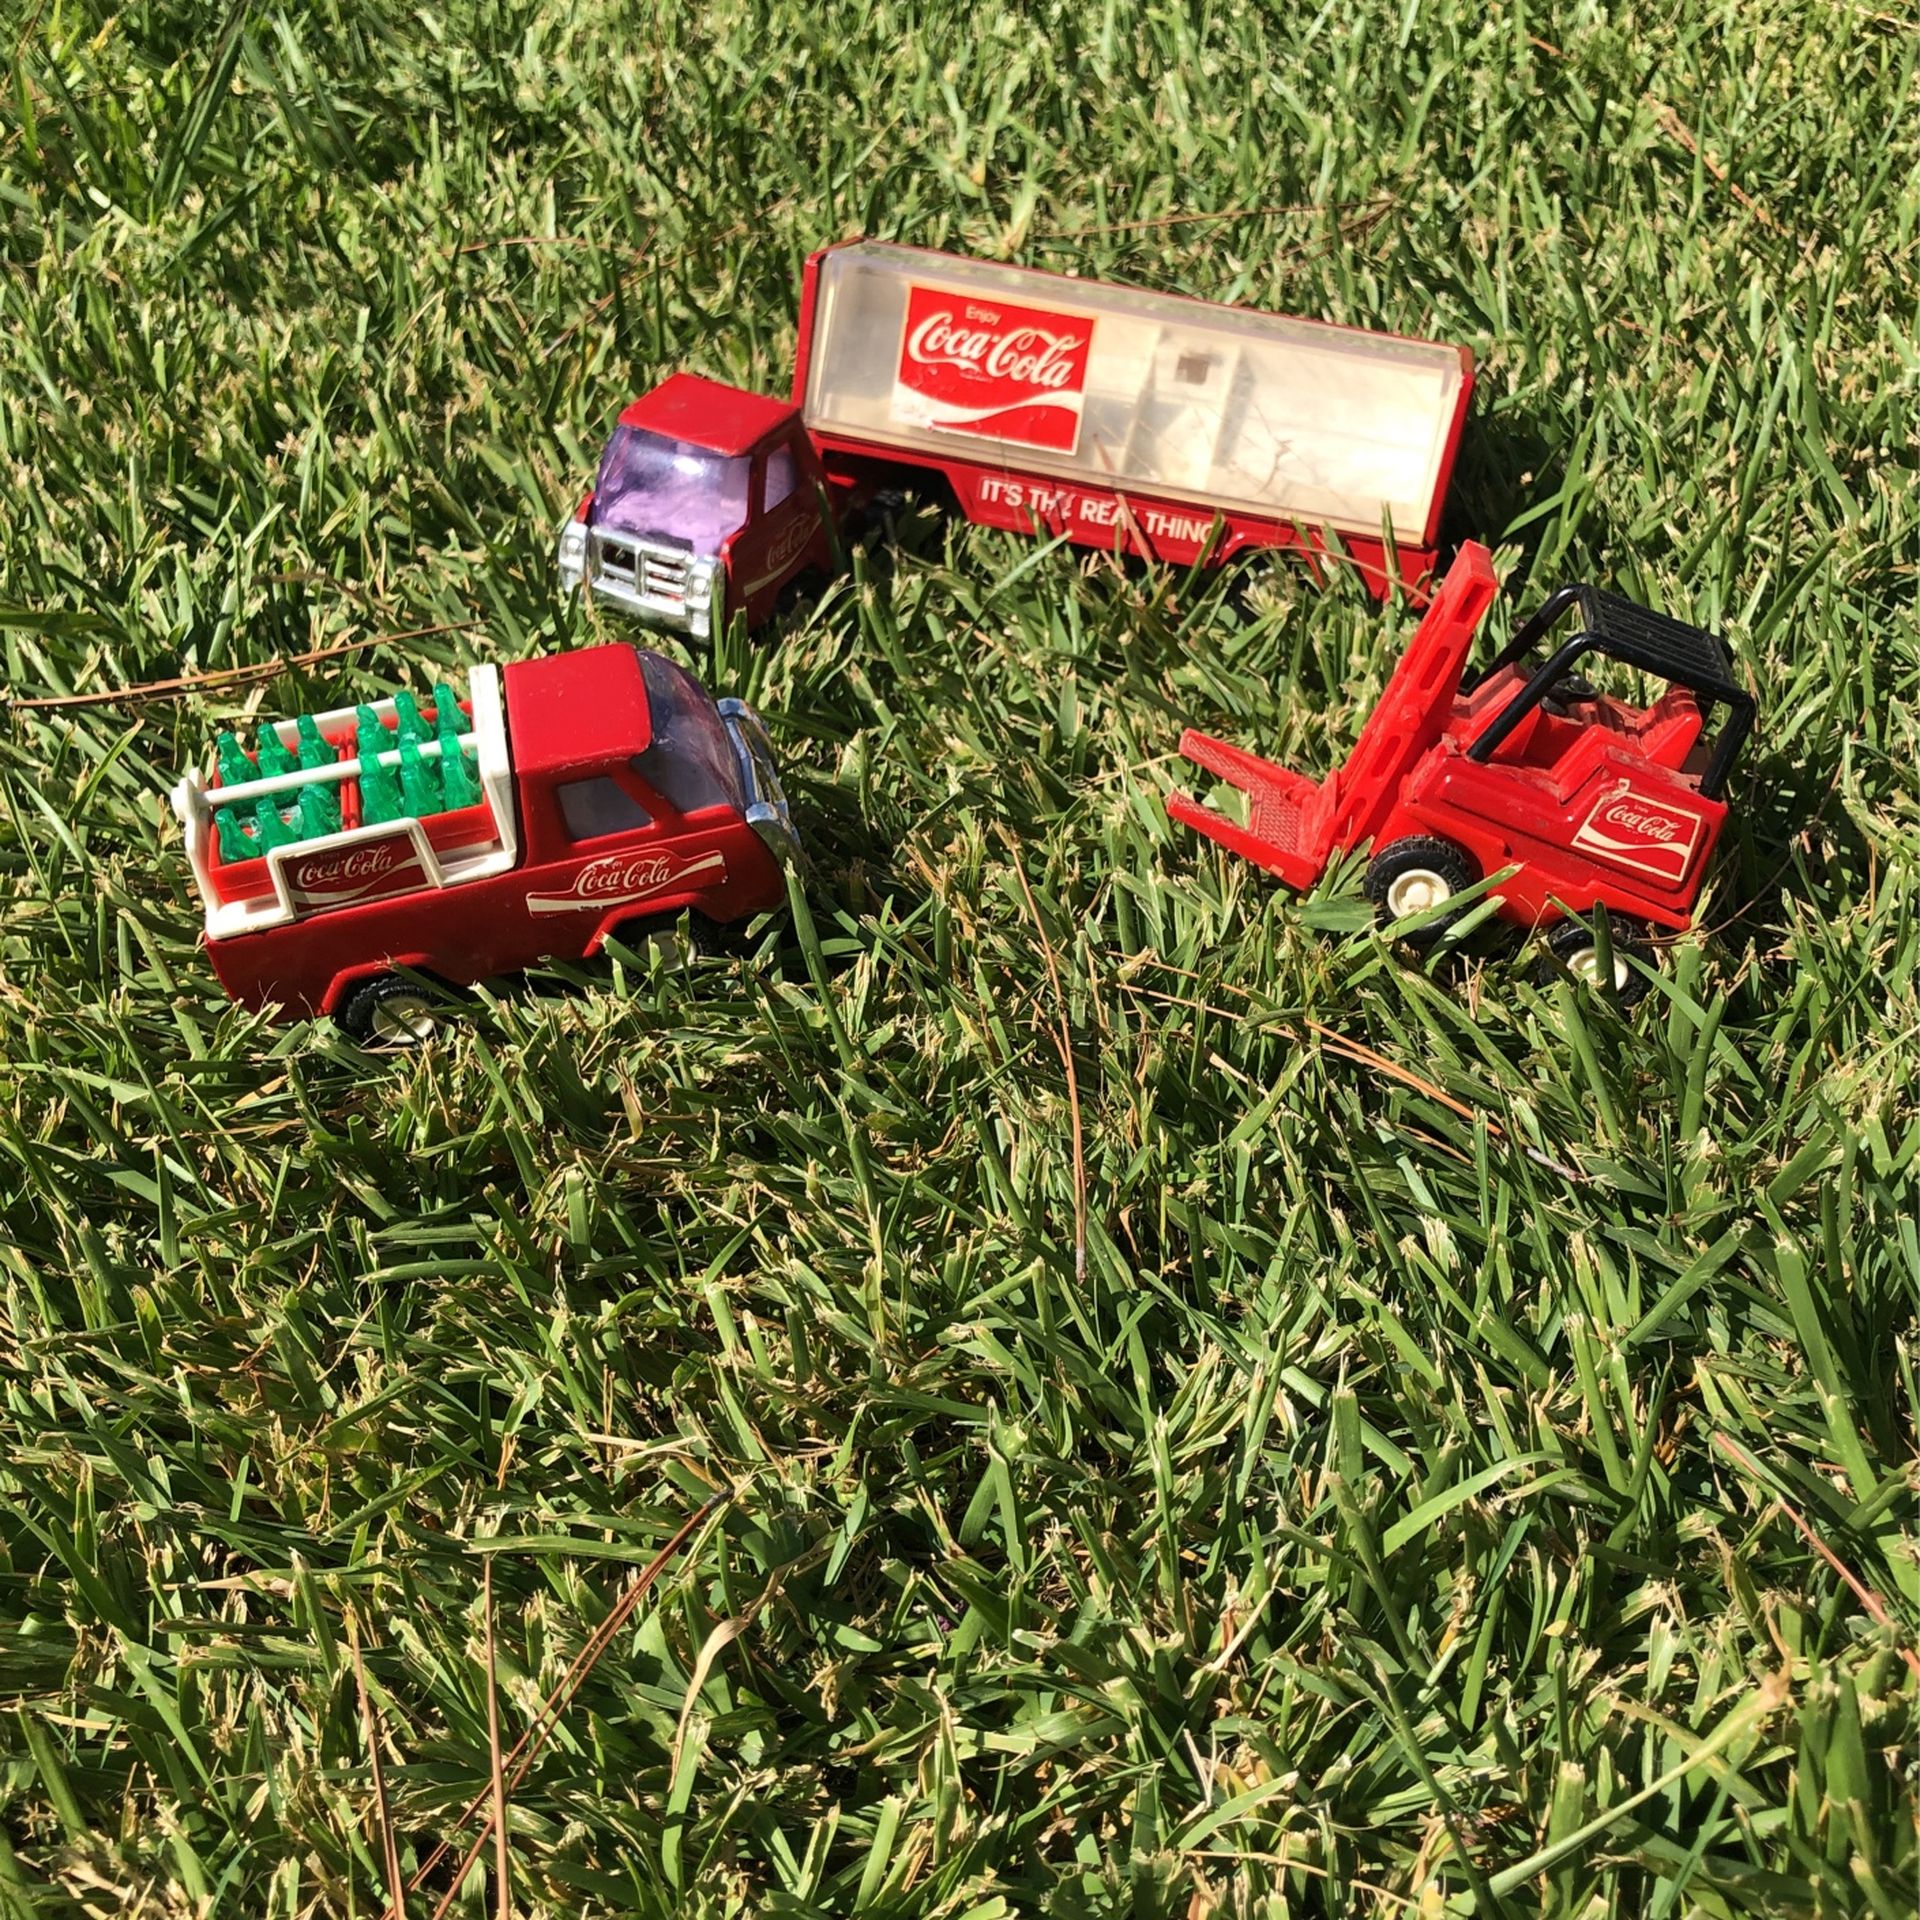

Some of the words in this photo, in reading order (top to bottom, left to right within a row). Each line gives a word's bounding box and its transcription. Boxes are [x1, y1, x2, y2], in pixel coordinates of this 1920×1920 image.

[964, 304, 1001, 326] Enjoy
[907, 311, 1086, 387] Coca-Cola
[980, 478, 1023, 507] IT'S
[1079, 498, 1137, 532] REA
[1605, 804, 1682, 841] Coca-Cola
[296, 844, 393, 888] Coca-Cola
[577, 856, 671, 896] Coca-Cola
